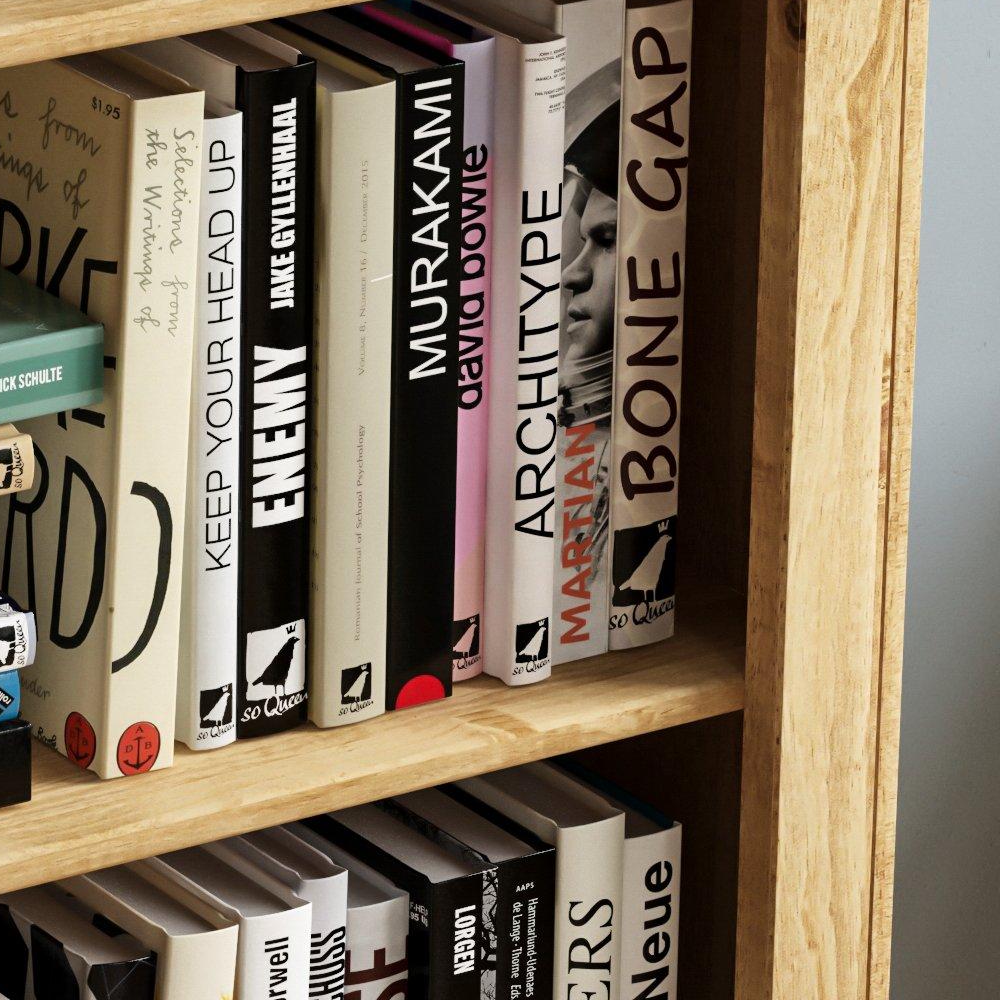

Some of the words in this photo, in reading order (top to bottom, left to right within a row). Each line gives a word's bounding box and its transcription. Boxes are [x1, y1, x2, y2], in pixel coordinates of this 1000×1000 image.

[91, 96, 122, 121] $1.95
[626, 26, 688, 212] GAP
[145, 128, 167, 170] the
[208, 139, 236, 194] UP
[271, 97, 297, 249] GYLLENHAAL
[63, 168, 90, 219] of
[170, 127, 199, 254] Selections
[133, 185, 164, 292] Writings
[409, 77, 452, 381] MURAKAMI
[207, 208, 235, 324] HEAD
[270, 251, 295, 310] JAKE
[133, 306, 160, 333] of
[161, 275, 189, 337] from
[18, 366, 64, 389] SCHULTE
[515, 182, 563, 538] ARCHITYPE
[620, 252, 682, 501] BONE
[206, 336, 235, 457] YOUR
[12, 442, 24, 477] Queen
[252, 345, 307, 528] ENEMY
[356, 424, 366, 487] Psychology
[205, 470, 232, 571] KEEP
[356, 491, 365, 530] School
[559, 423, 596, 643] MARTIAN
[14, 620, 27, 654] Queen
[609, 612, 629, 631] so
[241, 705, 262, 722] so
[264, 692, 309, 717] Queen
[512, 901, 524, 913] de
[515, 881, 535, 893] AAPS
[453, 904, 476, 976] LORGEN
[509, 914, 523, 942] Lange
[631, 860, 673, 1000] Neue
[264, 936, 290, 1000] rwell
[511, 946, 523, 979] Thorne
